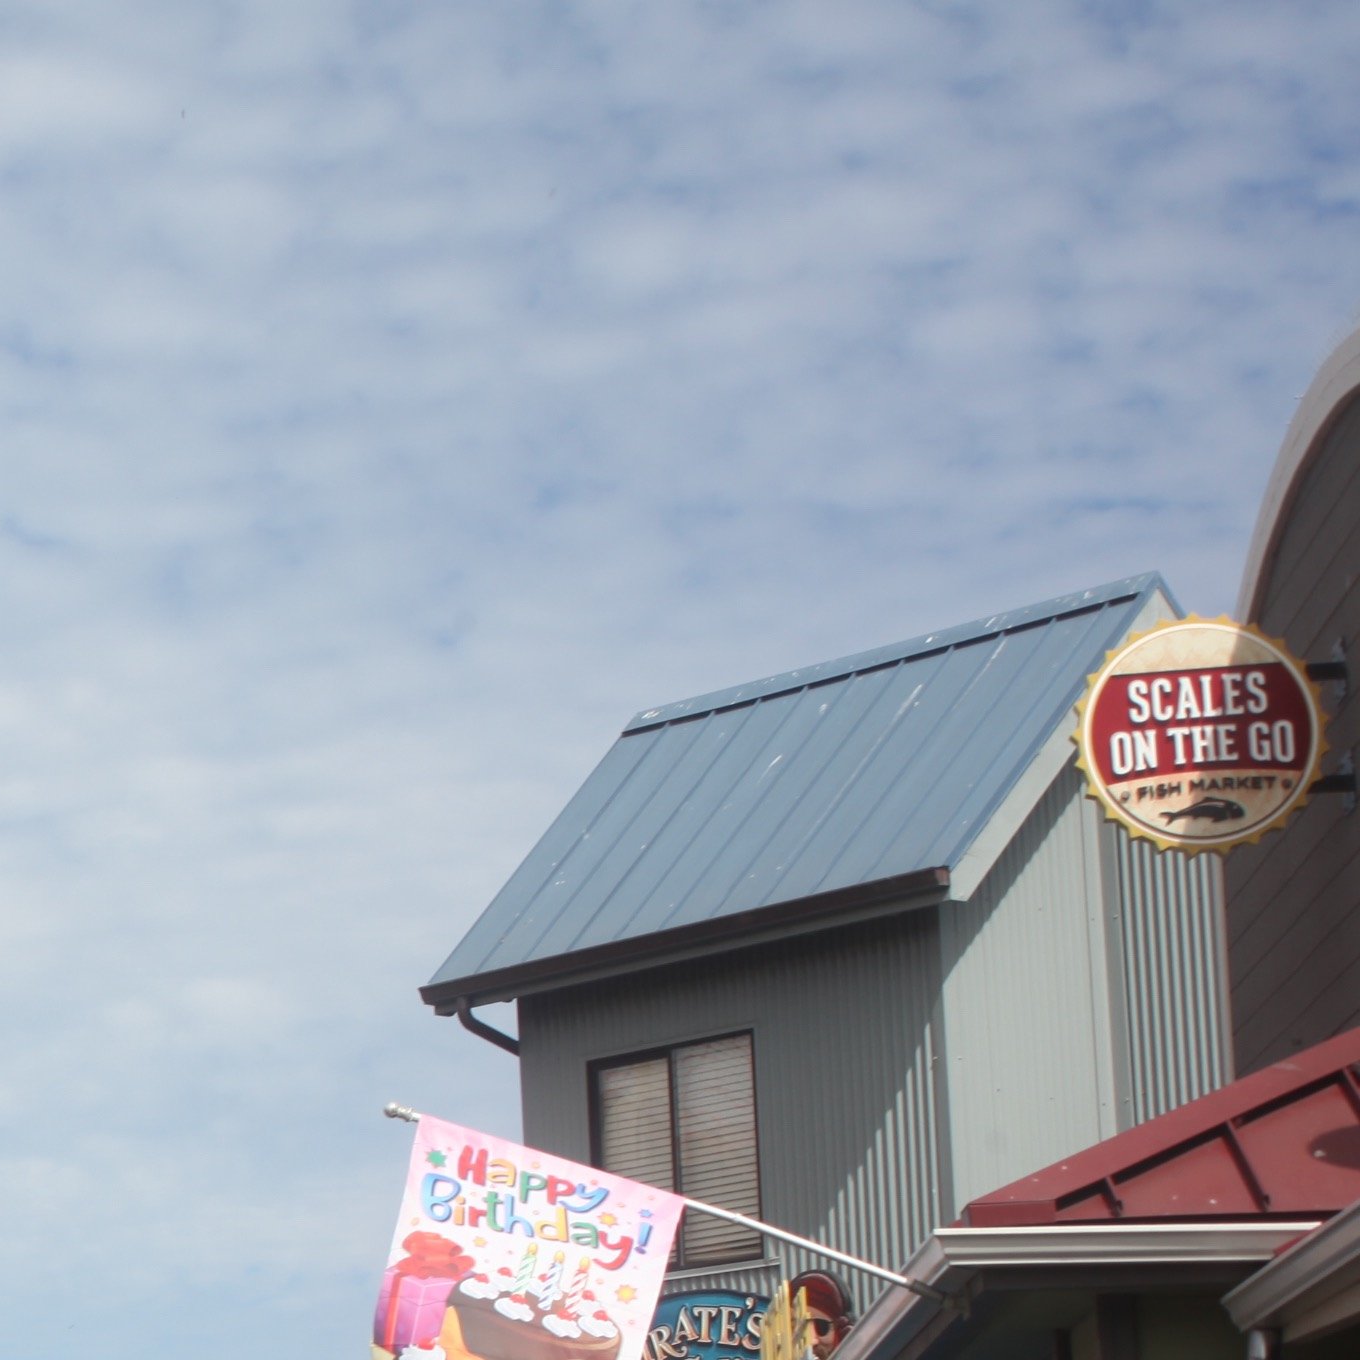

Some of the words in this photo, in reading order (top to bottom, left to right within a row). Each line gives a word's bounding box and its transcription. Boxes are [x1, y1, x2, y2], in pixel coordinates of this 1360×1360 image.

[1128, 671, 1268, 724] SCALES
[1110, 729, 1158, 776] ON
[1167, 724, 1239, 765] THE
[1248, 719, 1296, 763] GO
[1137, 781, 1182, 801] FISH
[1188, 775, 1278, 794] MARKET
[457, 1144, 610, 1213] Happy
[421, 1172, 654, 1270] Birthday!
